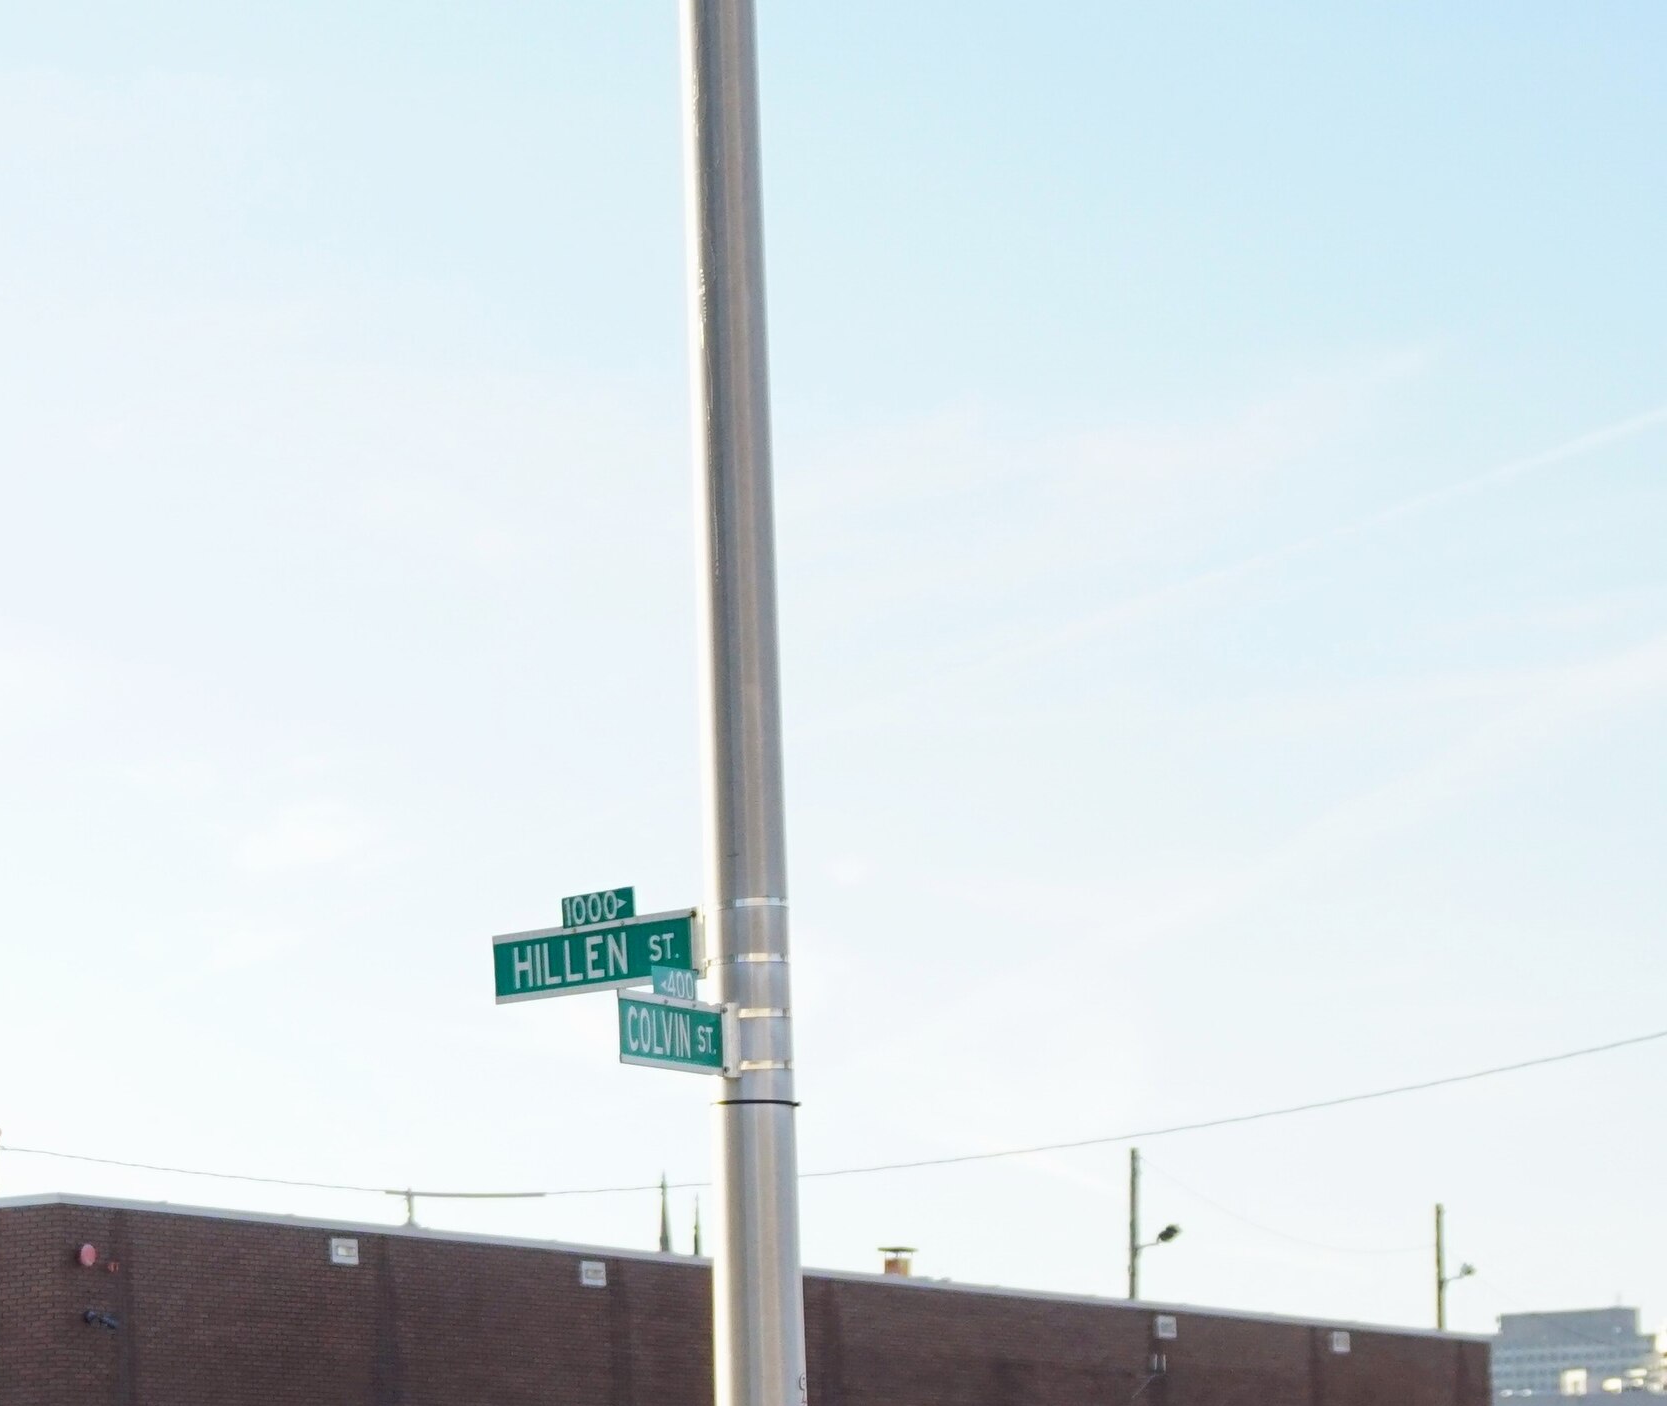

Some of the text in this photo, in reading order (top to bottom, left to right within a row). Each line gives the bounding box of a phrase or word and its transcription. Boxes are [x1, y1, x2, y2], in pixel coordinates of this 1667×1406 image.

[564, 889, 618, 927] 1000
[513, 931, 629, 989] HILLEN
[667, 970, 694, 1000] 400
[627, 1004, 691, 1058] COLVIN
